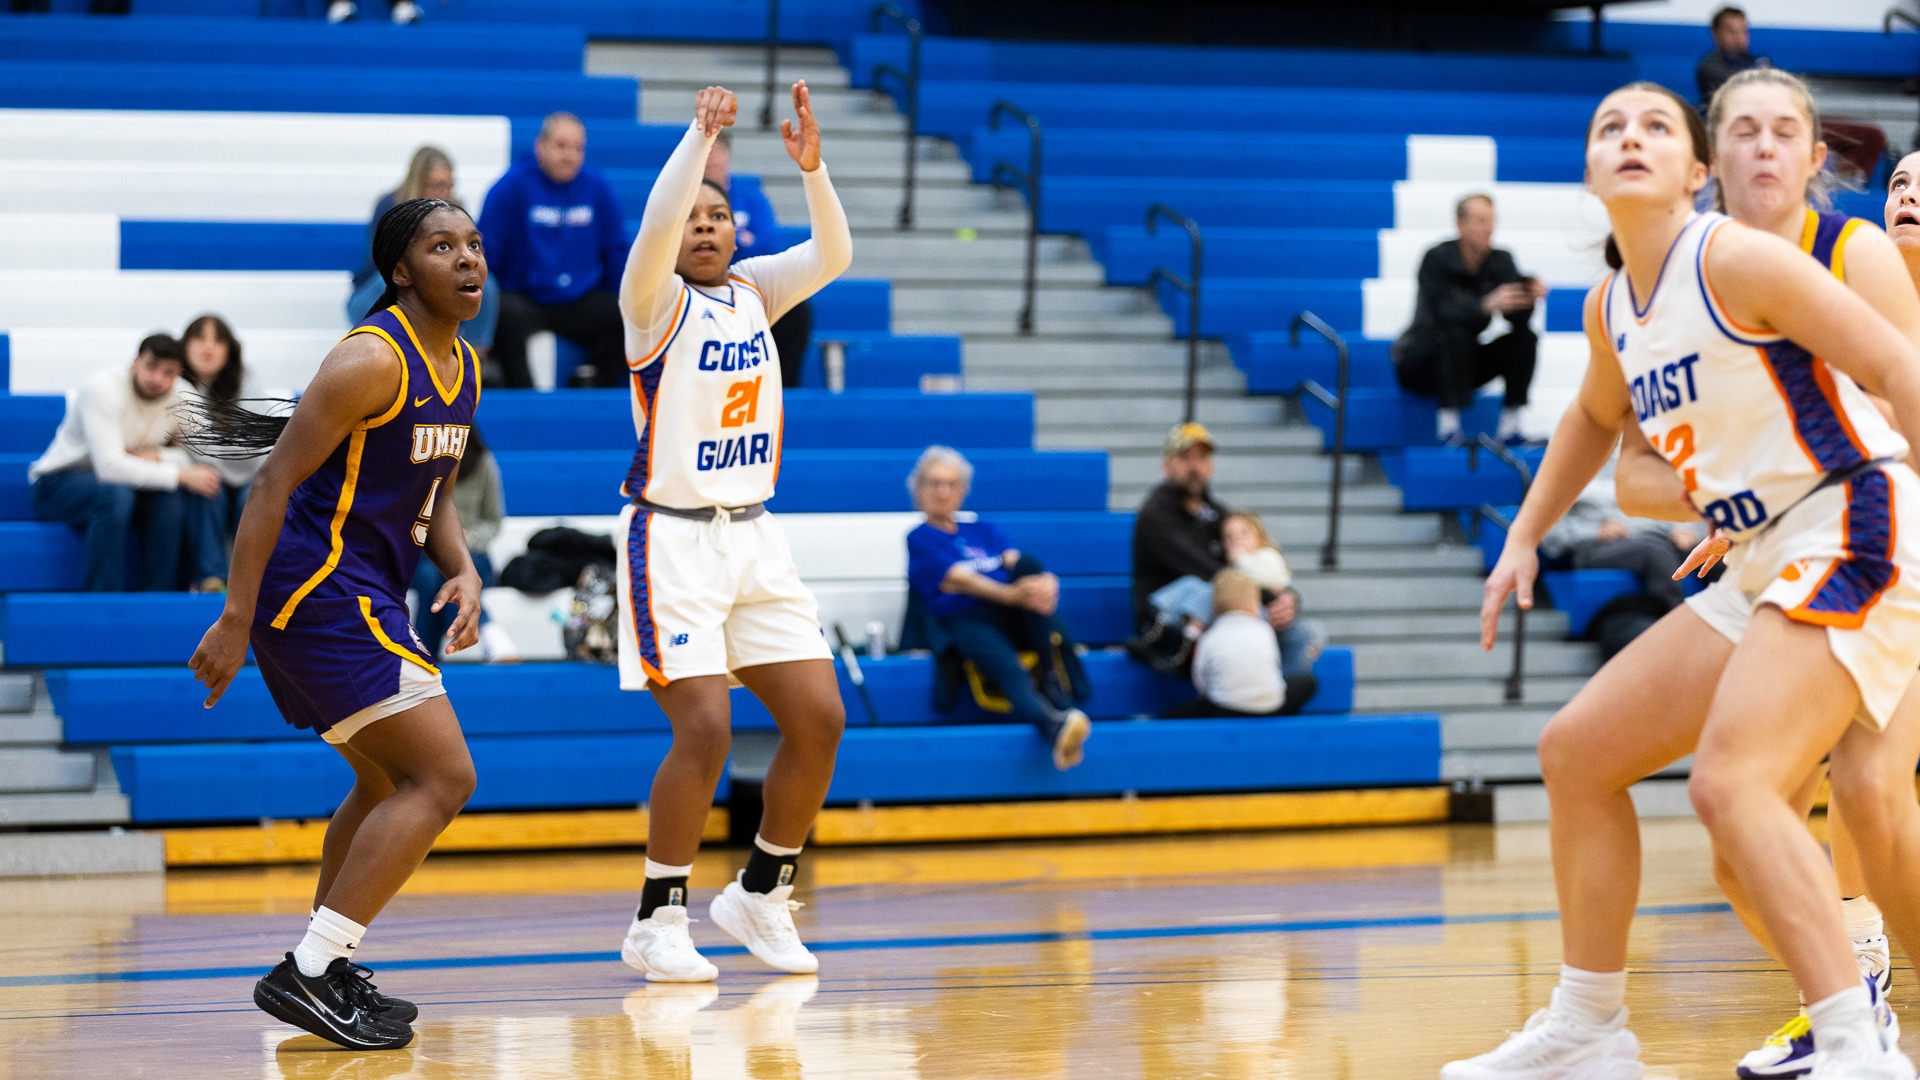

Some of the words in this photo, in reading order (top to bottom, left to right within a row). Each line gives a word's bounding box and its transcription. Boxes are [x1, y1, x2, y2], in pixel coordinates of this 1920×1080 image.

[698, 330, 769, 372] COAST
[720, 375, 763, 428] 21
[1628, 352, 1700, 423] OAST
[697, 432, 774, 471] GUAR
[1651, 423, 1698, 492] 2
